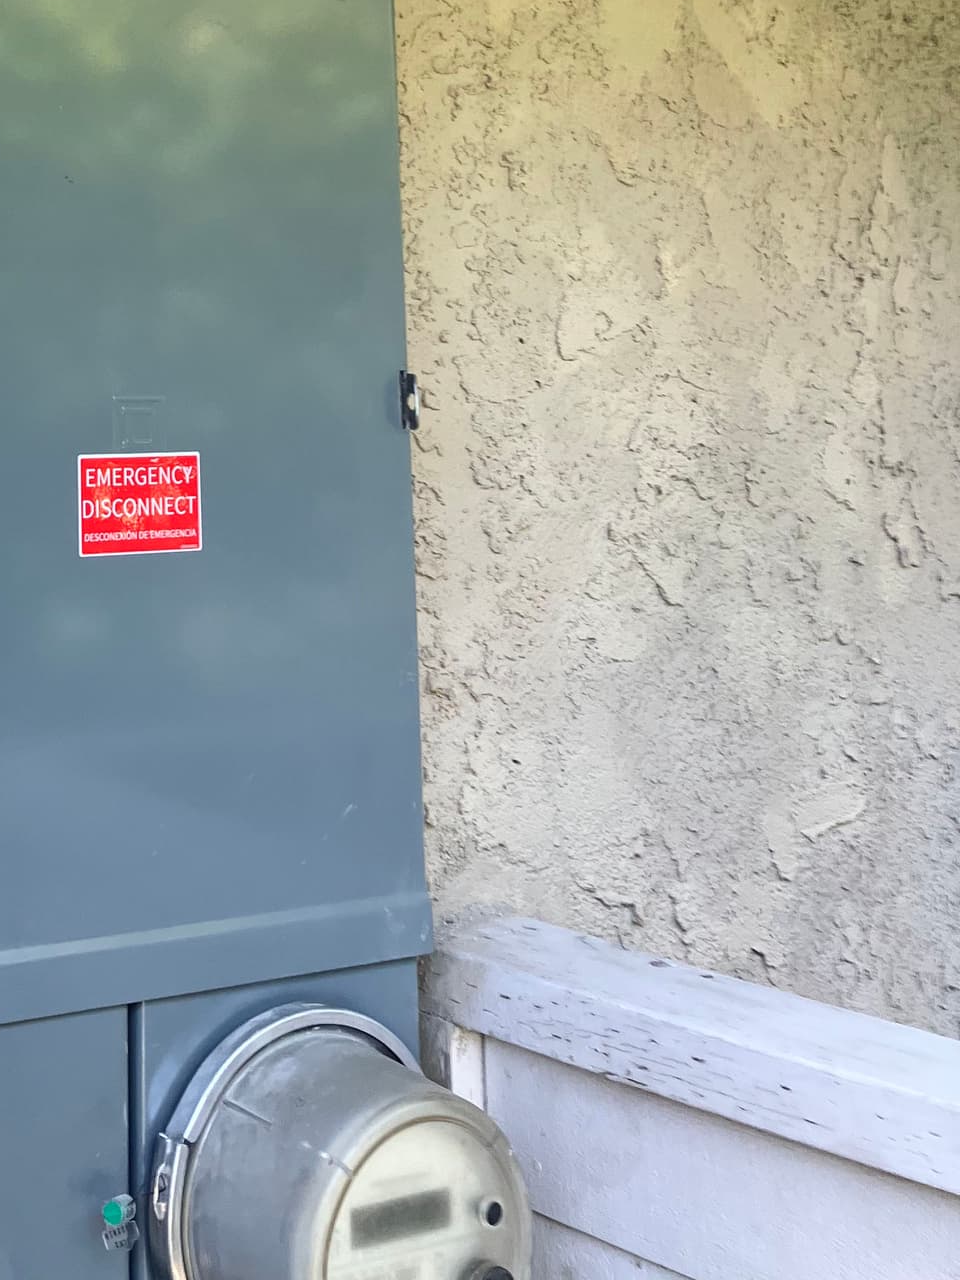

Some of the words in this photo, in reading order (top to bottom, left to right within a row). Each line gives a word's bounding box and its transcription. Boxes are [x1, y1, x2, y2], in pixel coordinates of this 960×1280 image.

[85, 465, 193, 487] EMERGENCY
[82, 495, 197, 519] DISCONNECT
[139, 530, 150, 540] DE
[150, 528, 197, 539] EMERGENCIA
